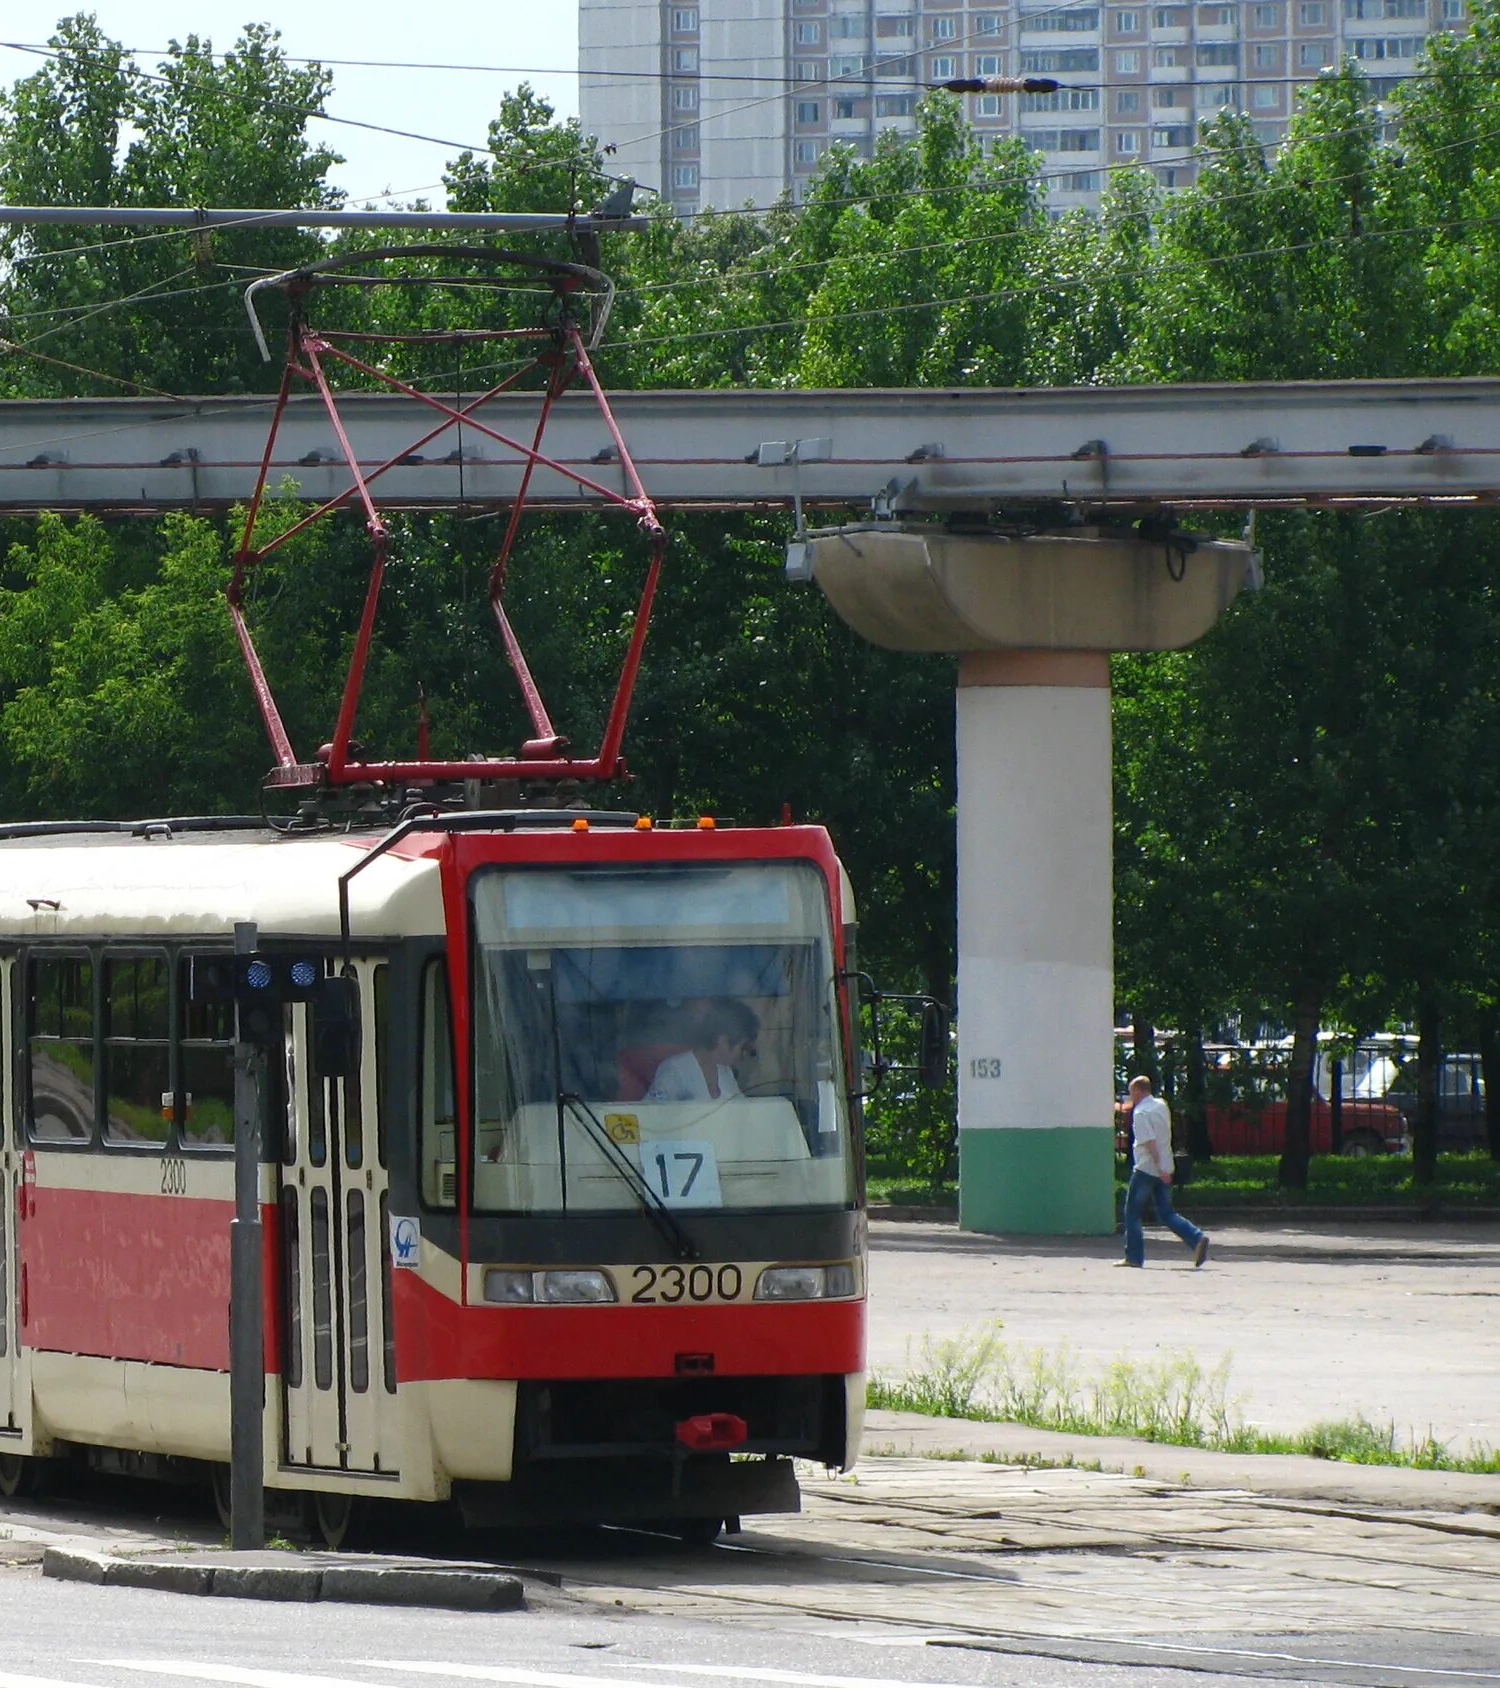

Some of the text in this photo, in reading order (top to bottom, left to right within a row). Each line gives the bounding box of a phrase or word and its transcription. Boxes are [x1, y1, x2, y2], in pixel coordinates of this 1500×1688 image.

[971, 1058, 1001, 1079] 153
[160, 1158, 186, 1195] 2300
[656, 1153, 703, 1198] 17
[632, 1264, 742, 1303] 2300
